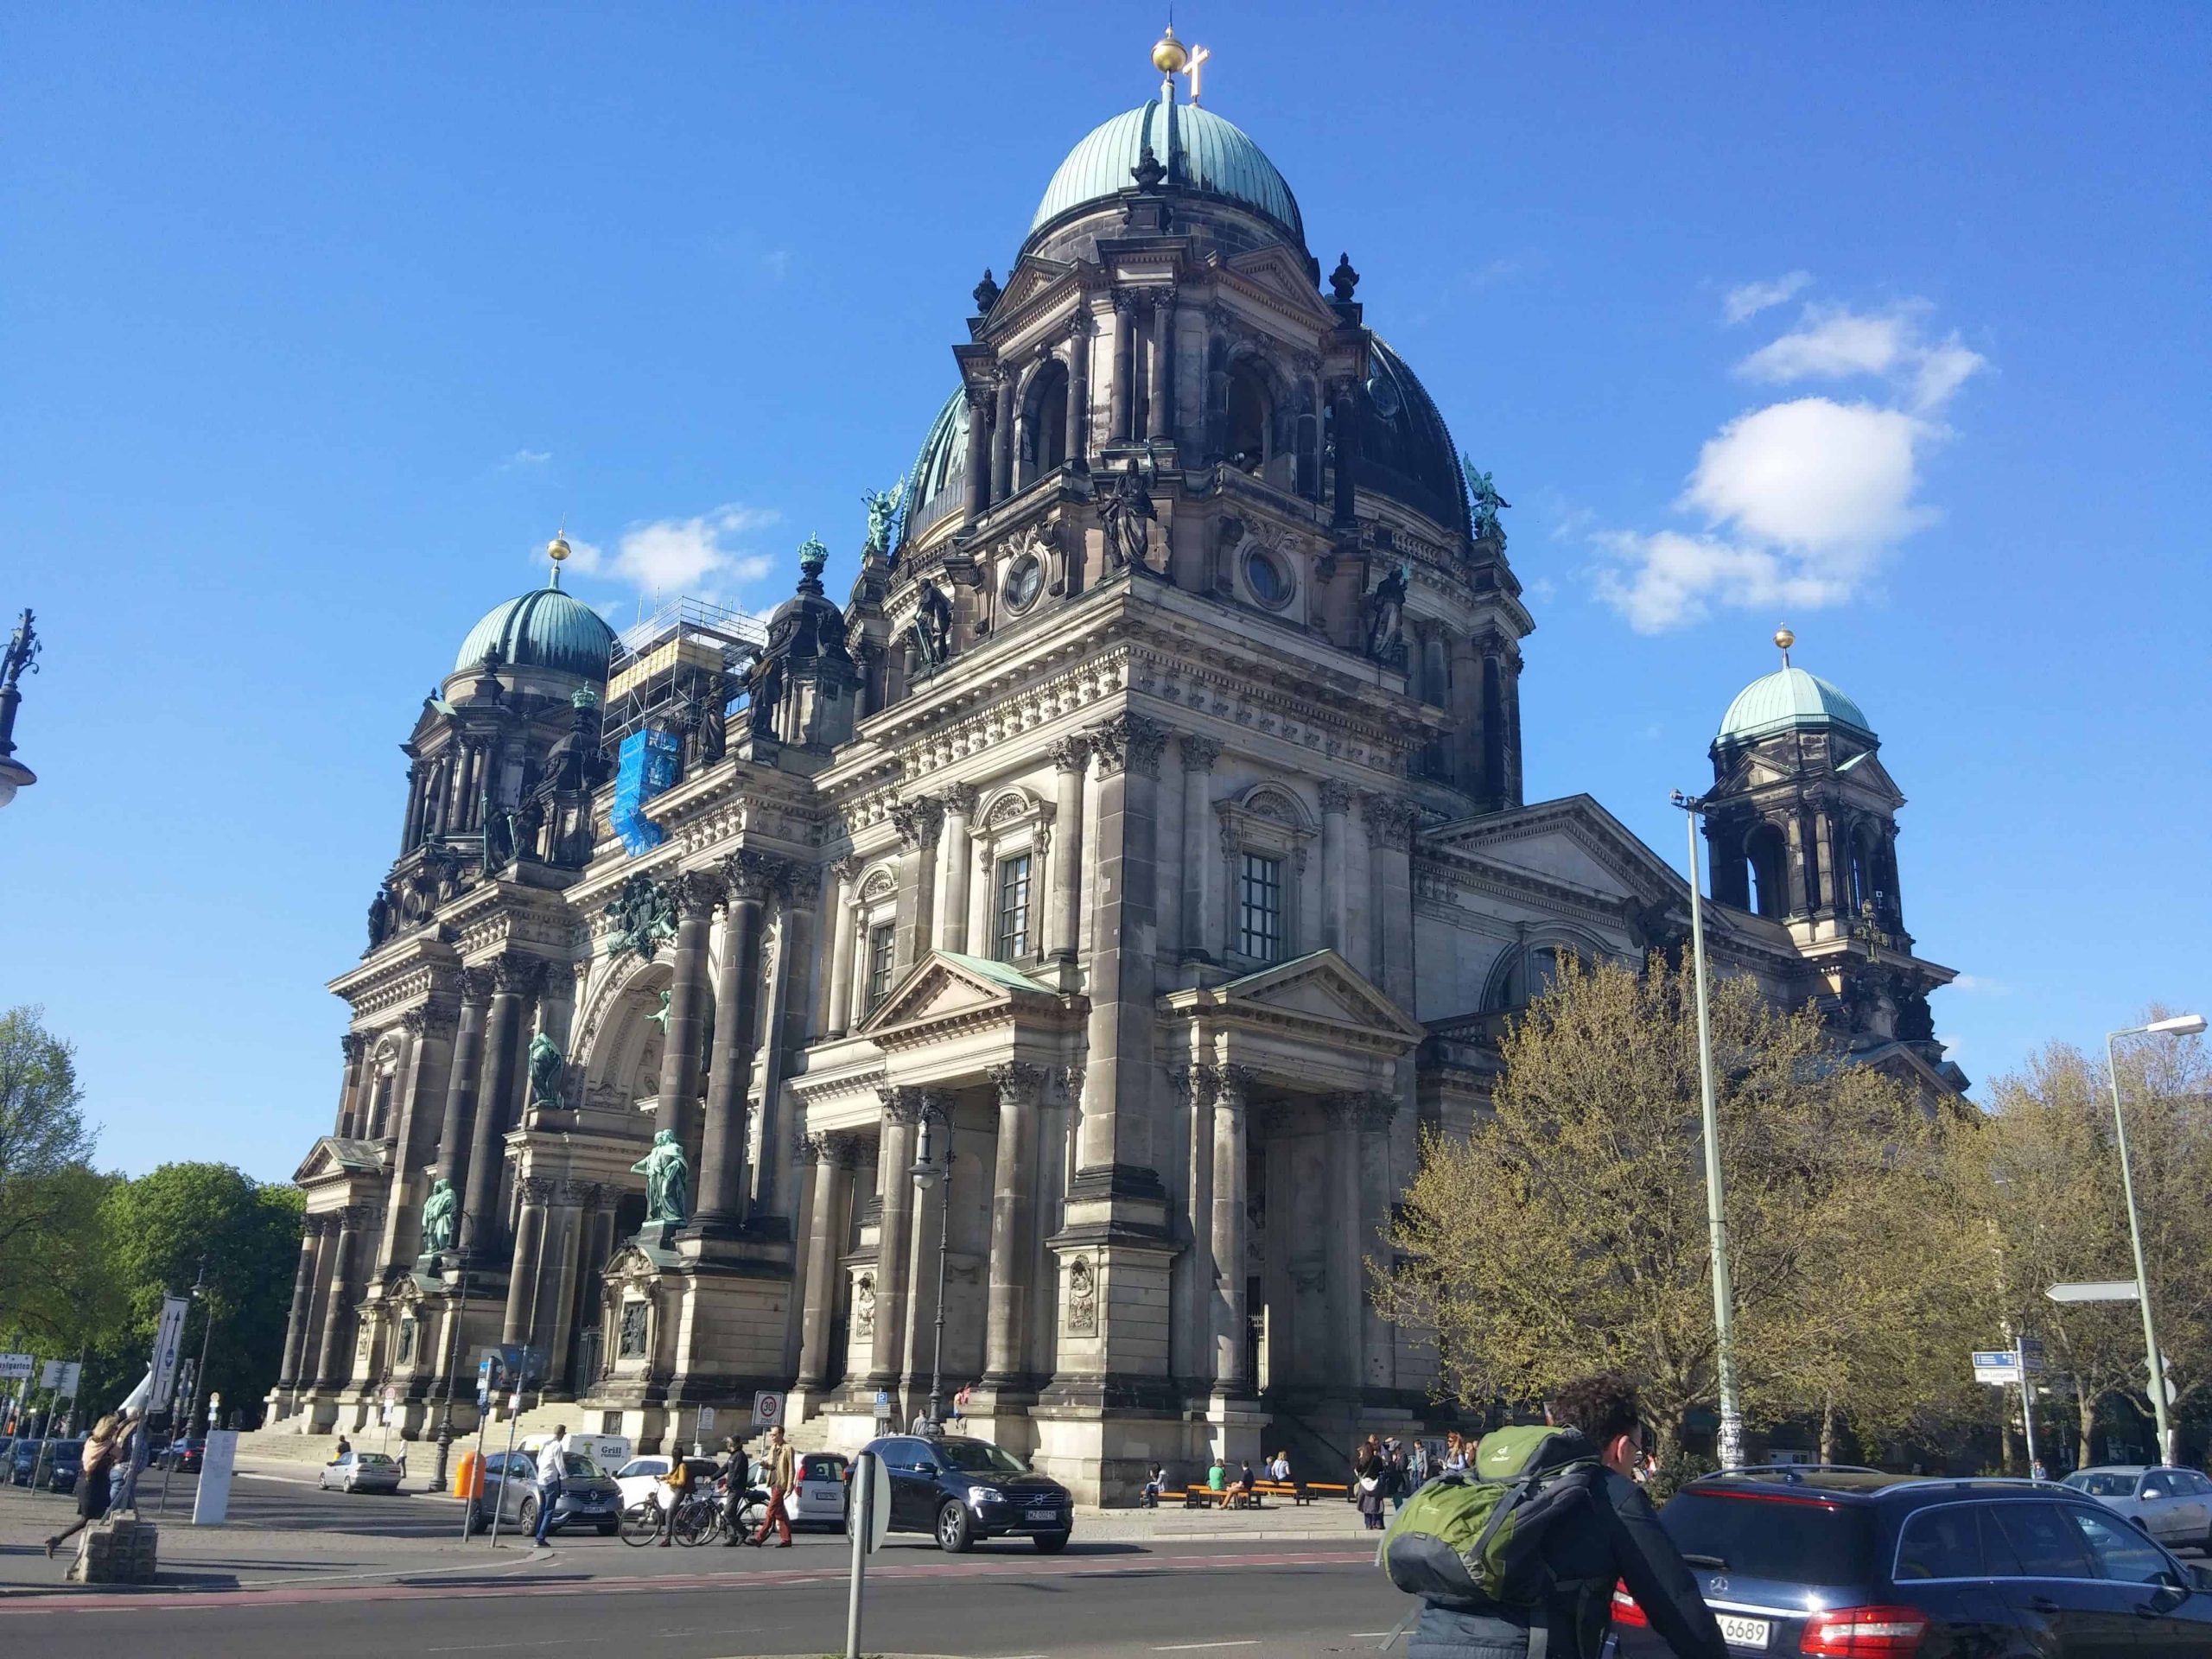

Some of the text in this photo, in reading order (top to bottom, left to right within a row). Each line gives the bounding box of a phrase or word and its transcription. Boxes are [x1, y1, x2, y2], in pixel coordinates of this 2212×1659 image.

[763, 1402, 773, 1412] 30
[601, 1446, 622, 1454] Grill
[1726, 1618, 1765, 1642] 6689
